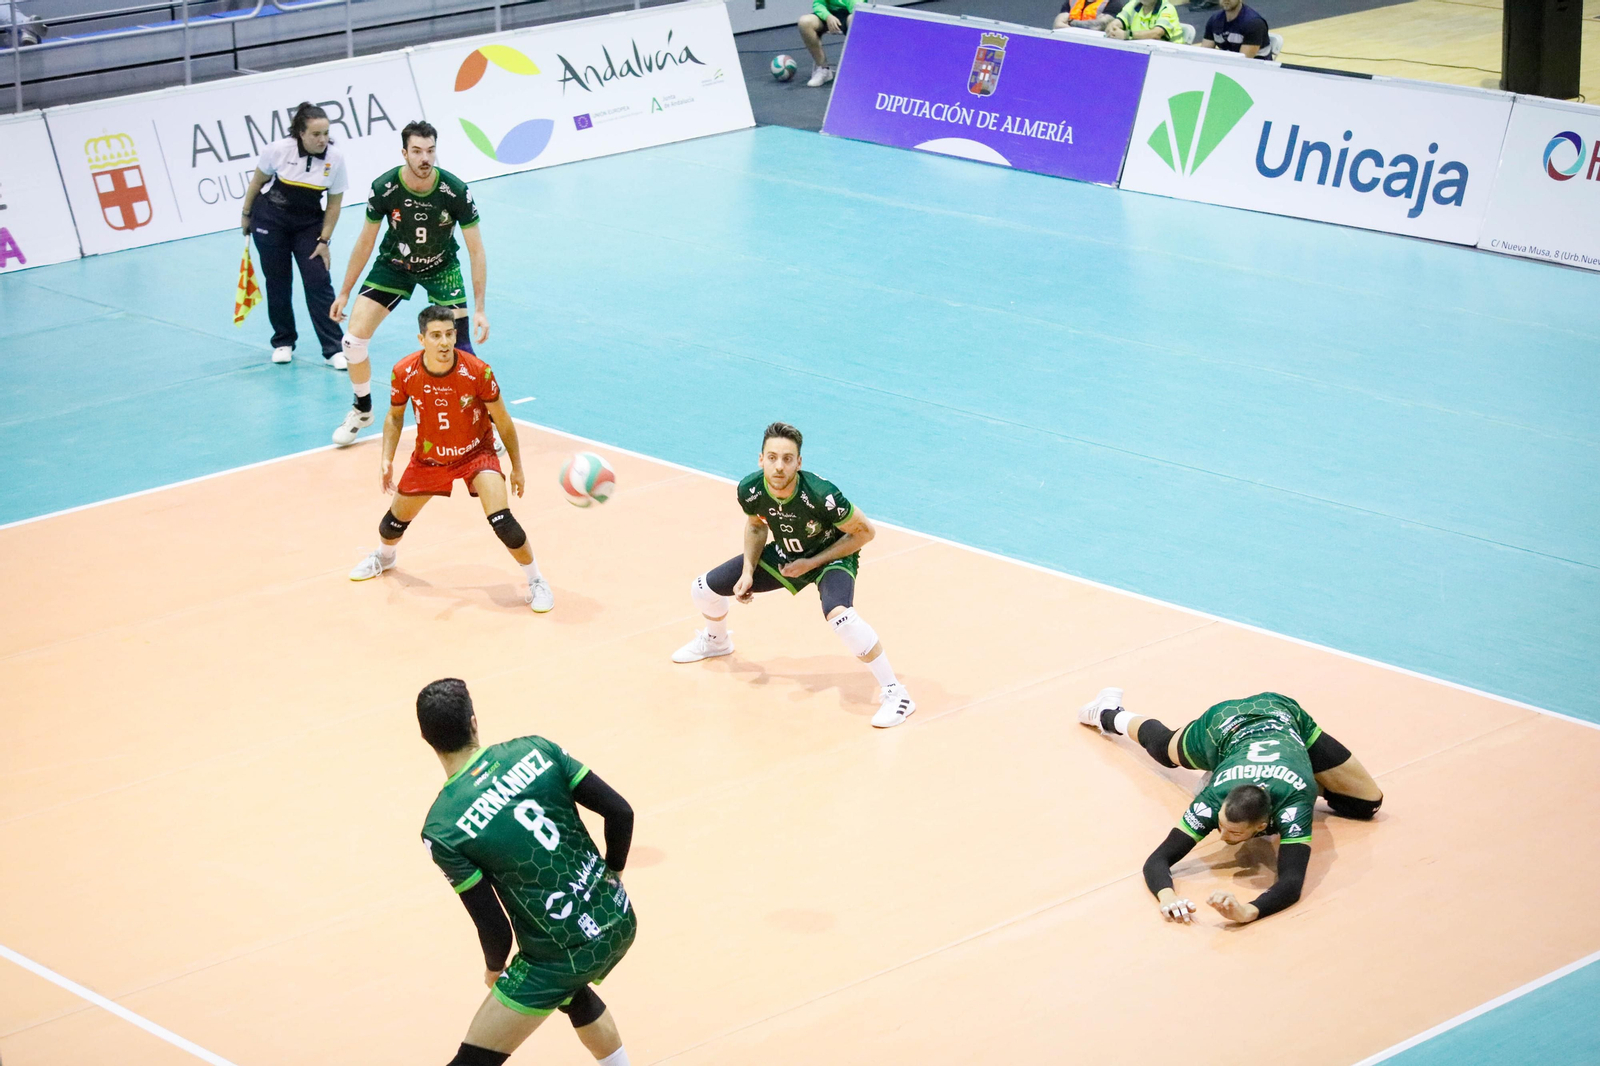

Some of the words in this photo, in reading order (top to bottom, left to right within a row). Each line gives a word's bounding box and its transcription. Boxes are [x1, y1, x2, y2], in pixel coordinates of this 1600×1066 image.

[875, 93, 975, 125] DIPUTACIÓN
[976, 111, 999, 131] DE
[1000, 115, 1074, 144] ALMERÍA
[1255, 120, 1469, 219] Unicaja
[415, 226, 427, 244] 9
[1501, 240, 1527, 253] Nueva
[1529, 246, 1552, 258] Musa,
[1554, 250, 1560, 259] 8
[437, 412, 450, 430] 5
[783, 537, 804, 552] 10
[1247, 739, 1280, 763] 3
[455, 748, 554, 839] FERNÁNDEZ
[513, 799, 560, 851] 8
